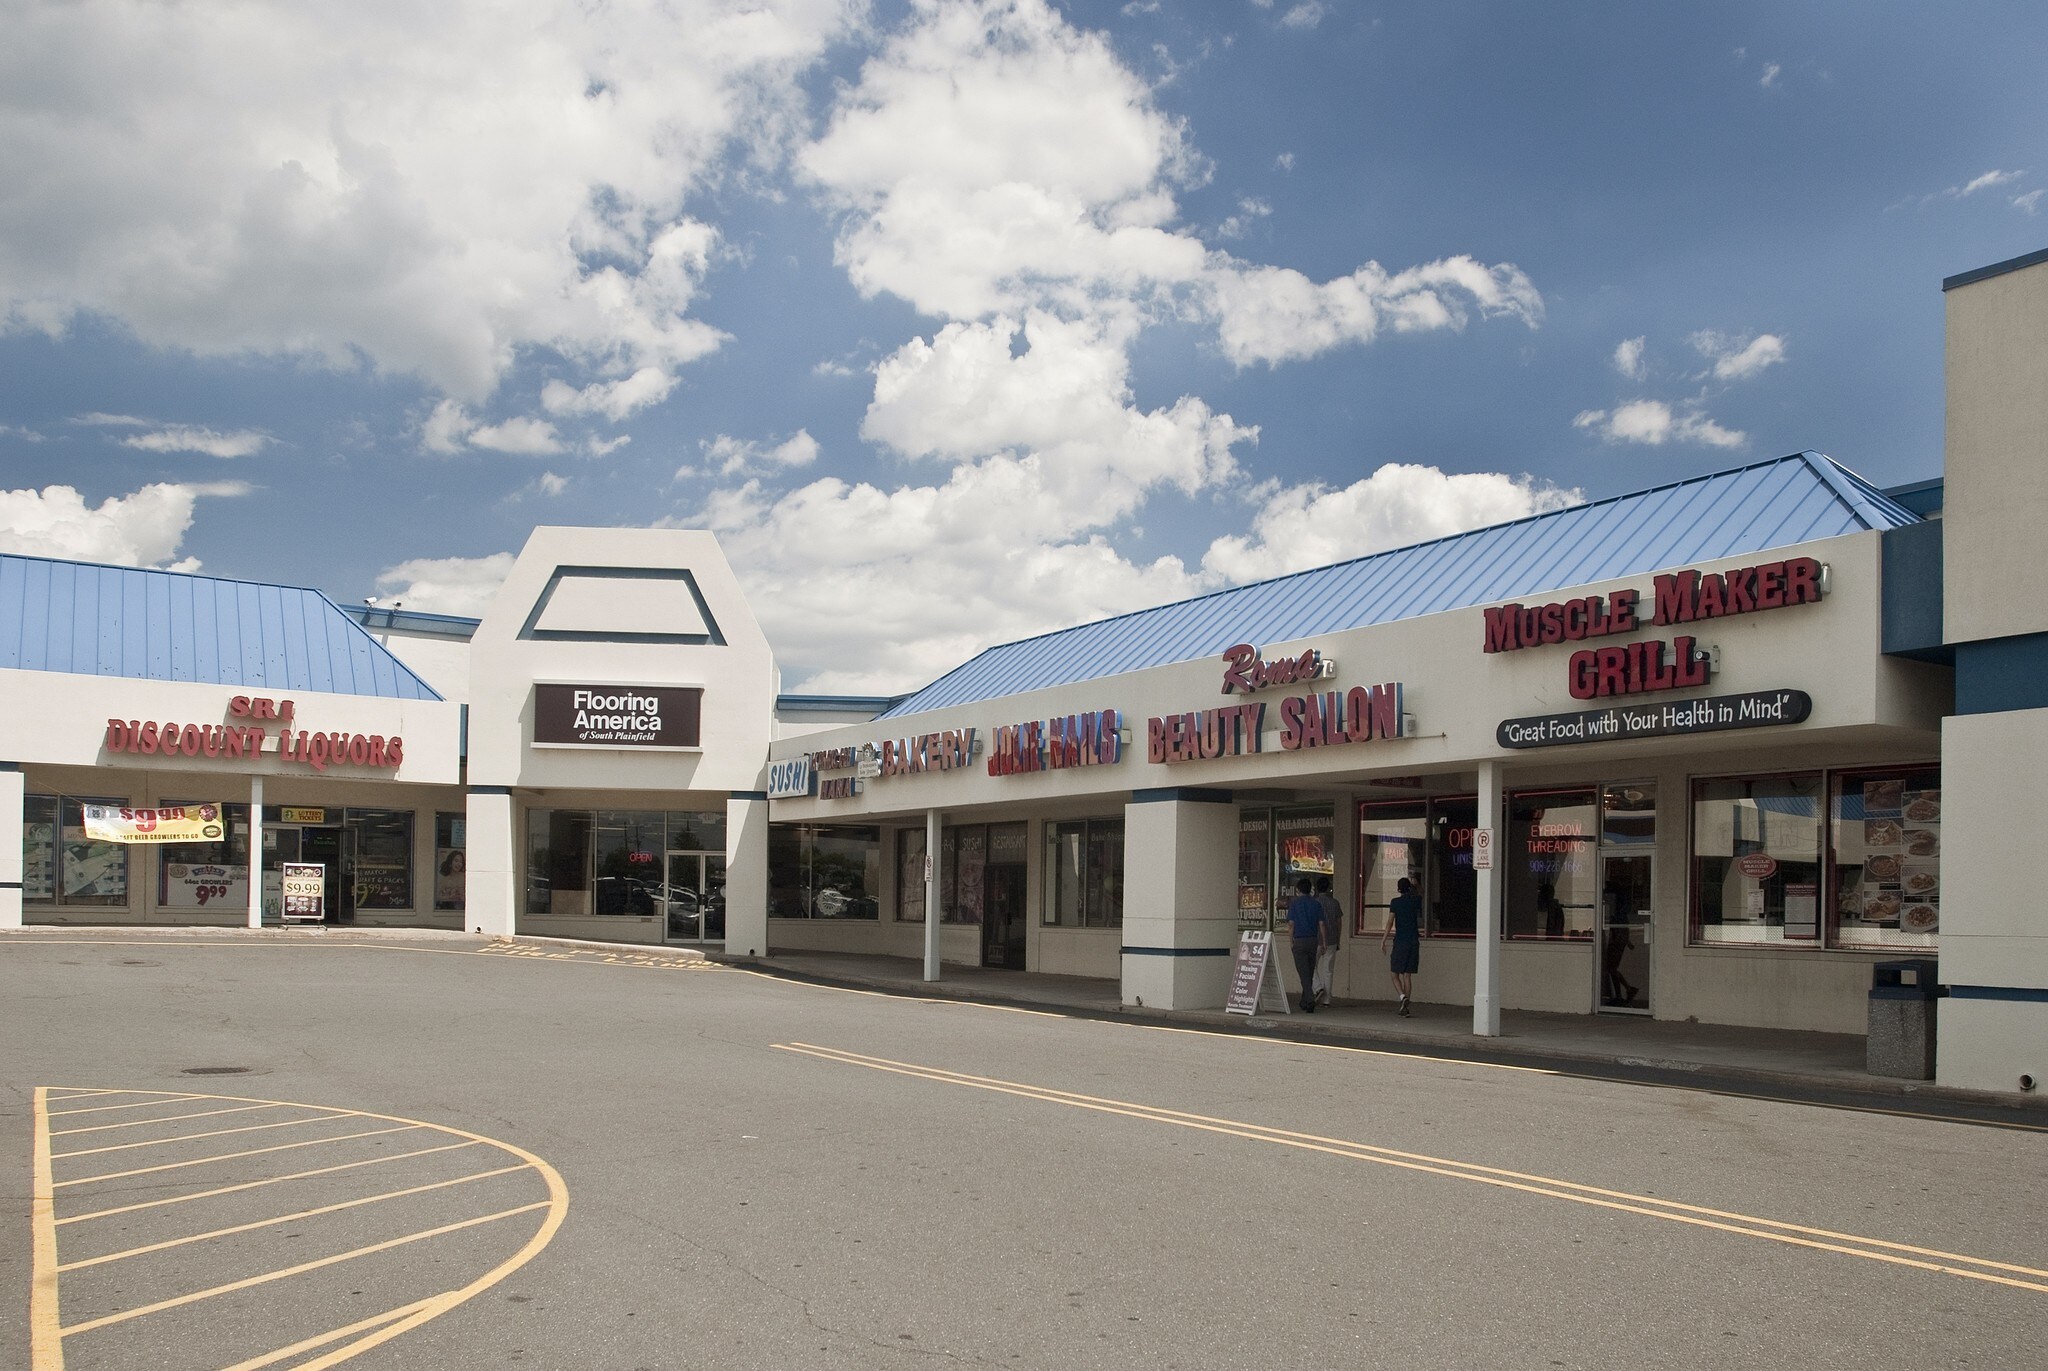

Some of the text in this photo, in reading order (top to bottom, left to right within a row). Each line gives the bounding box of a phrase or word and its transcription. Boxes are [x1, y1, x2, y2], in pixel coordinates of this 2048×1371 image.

[1484, 557, 1822, 653] MUSCLE MAKER
[1221, 643, 1321, 694] Roma
[1569, 636, 1710, 699] GRILL
[230, 695, 295, 720] SRI
[574, 690, 658, 715] Flooring
[573, 710, 661, 731] America
[1148, 682, 1403, 763] BEAUTY SALON
[1549, 720, 1584, 739] Food
[1588, 712, 1618, 735] with
[1622, 711, 1658, 731] Your
[1663, 701, 1713, 728] Health
[1718, 703, 1733, 723] in
[107, 718, 403, 770] DISCOUNT LIQUORS
[579, 731, 655, 742] of South Plainfield
[987, 708, 1122, 777] JOLIE NAILS
[882, 727, 976, 777] BAKERY
[769, 761, 807, 794] SUSHI
[820, 777, 855, 800] HANA
[1243, 820, 1267, 831] DESIGN
[1530, 823, 1582, 837] EYEBROW
[962, 837, 982, 850] SUSHI
[1385, 847, 1405, 860] HAIR
[1526, 839, 1586, 853] THREADING
[629, 853, 652, 863] OPEN
[286, 882, 320, 894] $9.99
[1281, 886, 1295, 896] Full
[1252, 944, 1264, 957] $4
[1234, 995, 1254, 1003] Highlights
